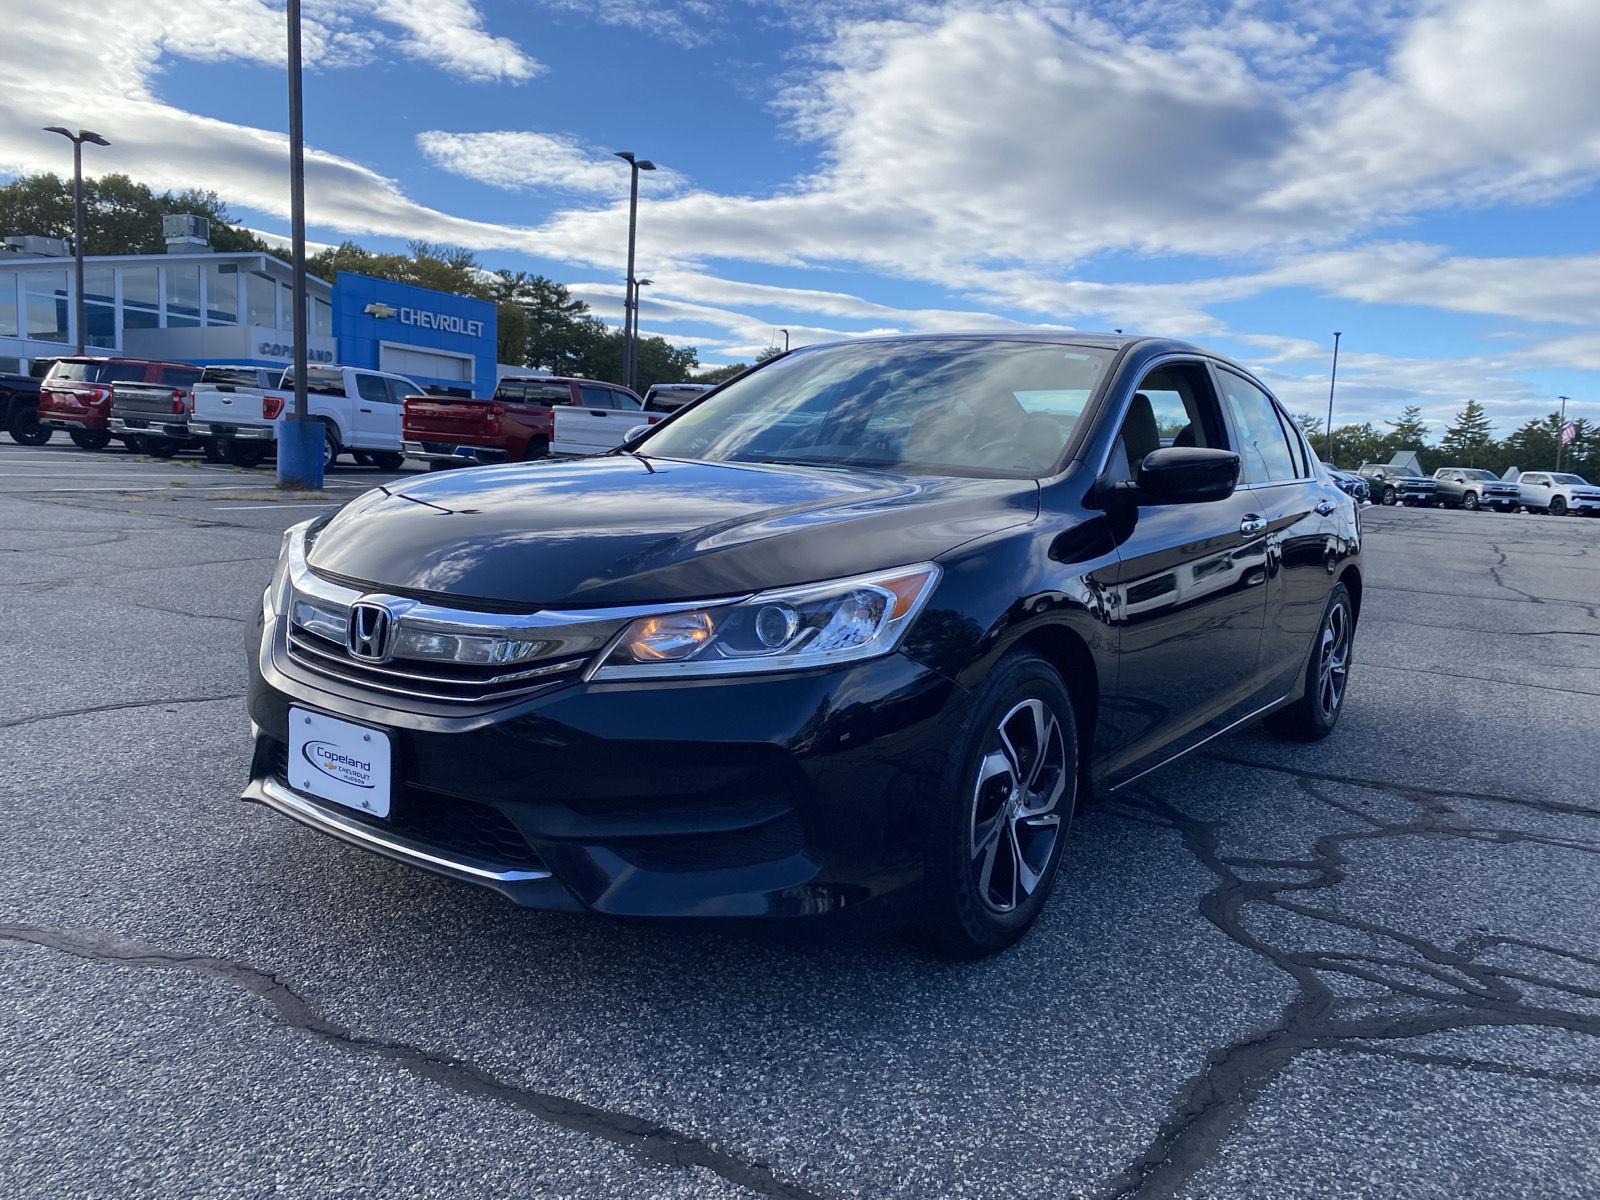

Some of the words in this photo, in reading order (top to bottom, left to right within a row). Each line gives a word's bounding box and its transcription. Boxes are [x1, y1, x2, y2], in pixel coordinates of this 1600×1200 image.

[400, 307, 484, 337] CHEVROLET
[259, 342, 333, 362] COPEAND
[316, 746, 371, 772] Copeland
[338, 766, 371, 780] CHEVROLET
